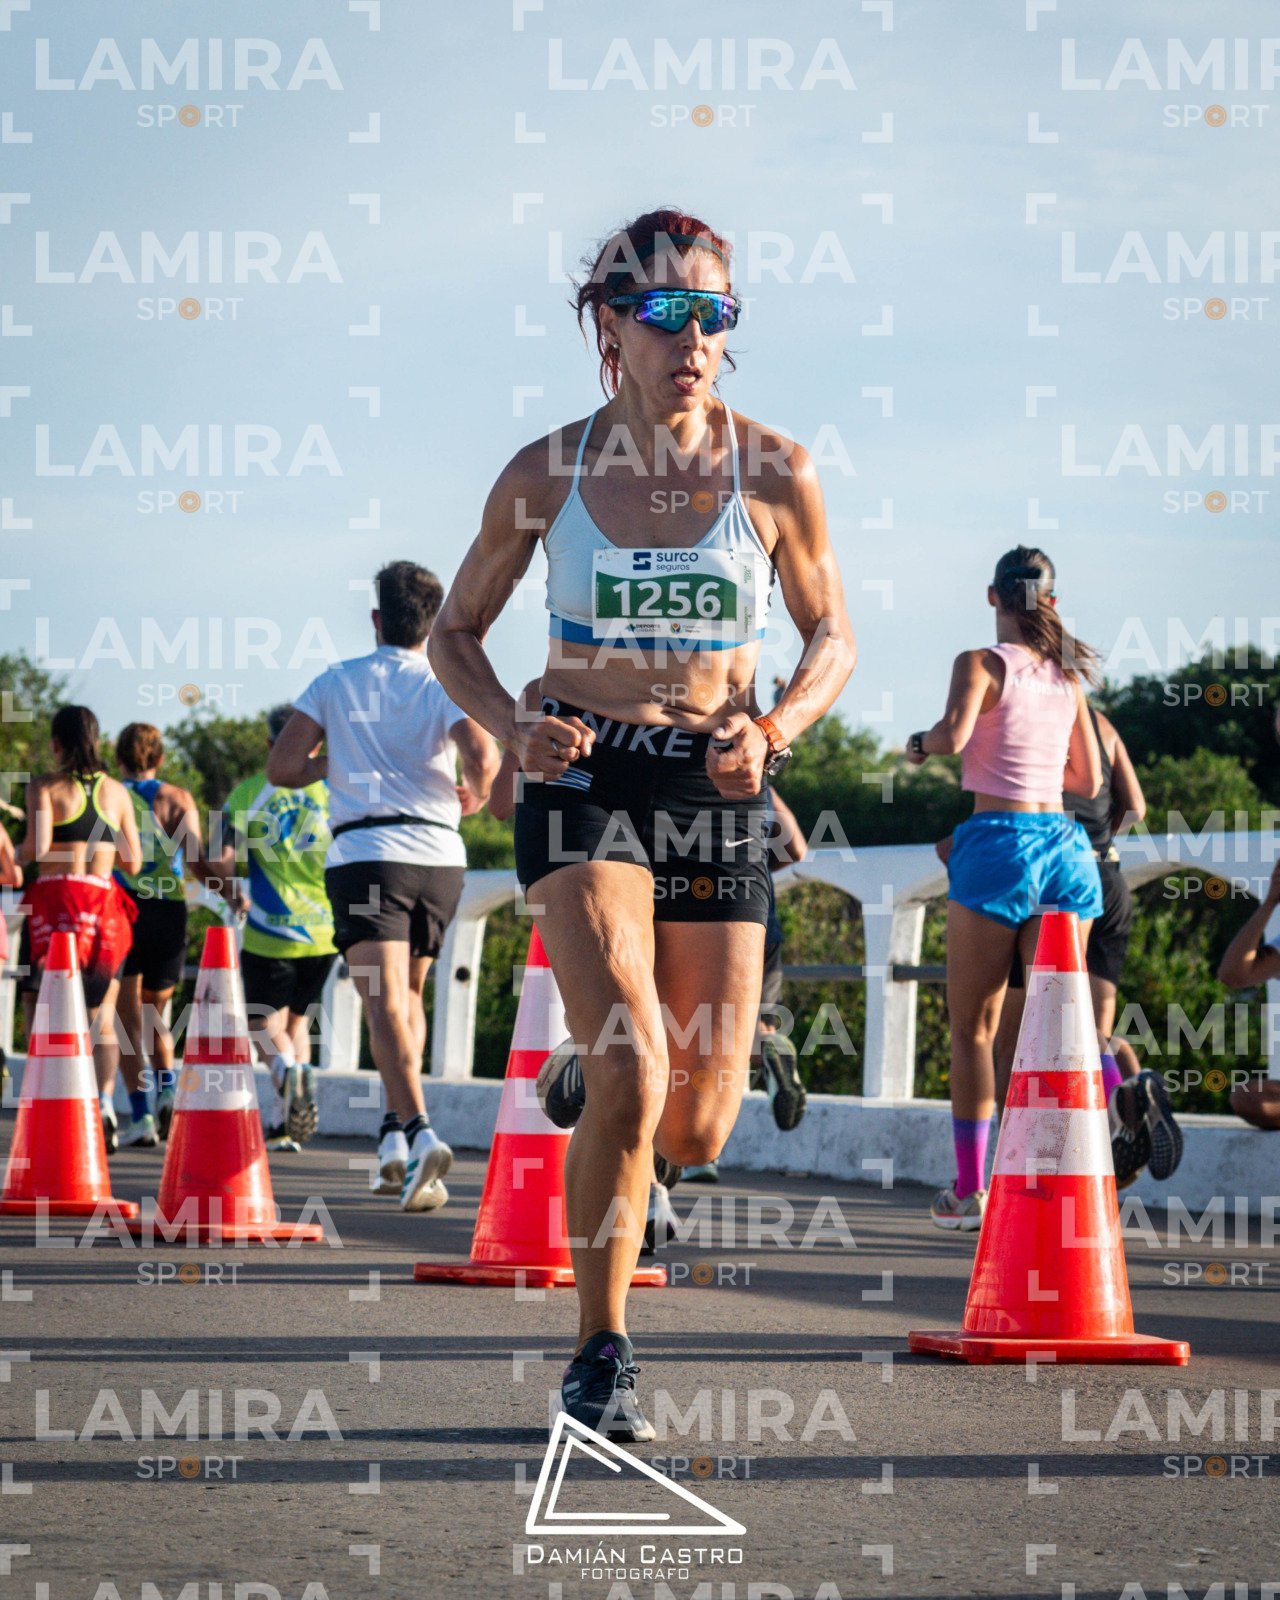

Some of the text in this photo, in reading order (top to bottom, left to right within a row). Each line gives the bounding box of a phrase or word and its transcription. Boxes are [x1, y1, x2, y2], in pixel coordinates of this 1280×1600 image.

[656, 551, 699, 563] surco
[656, 563, 690, 573] seguros
[612, 580, 722, 618] 1256
[581, 710, 698, 759] NIKE
